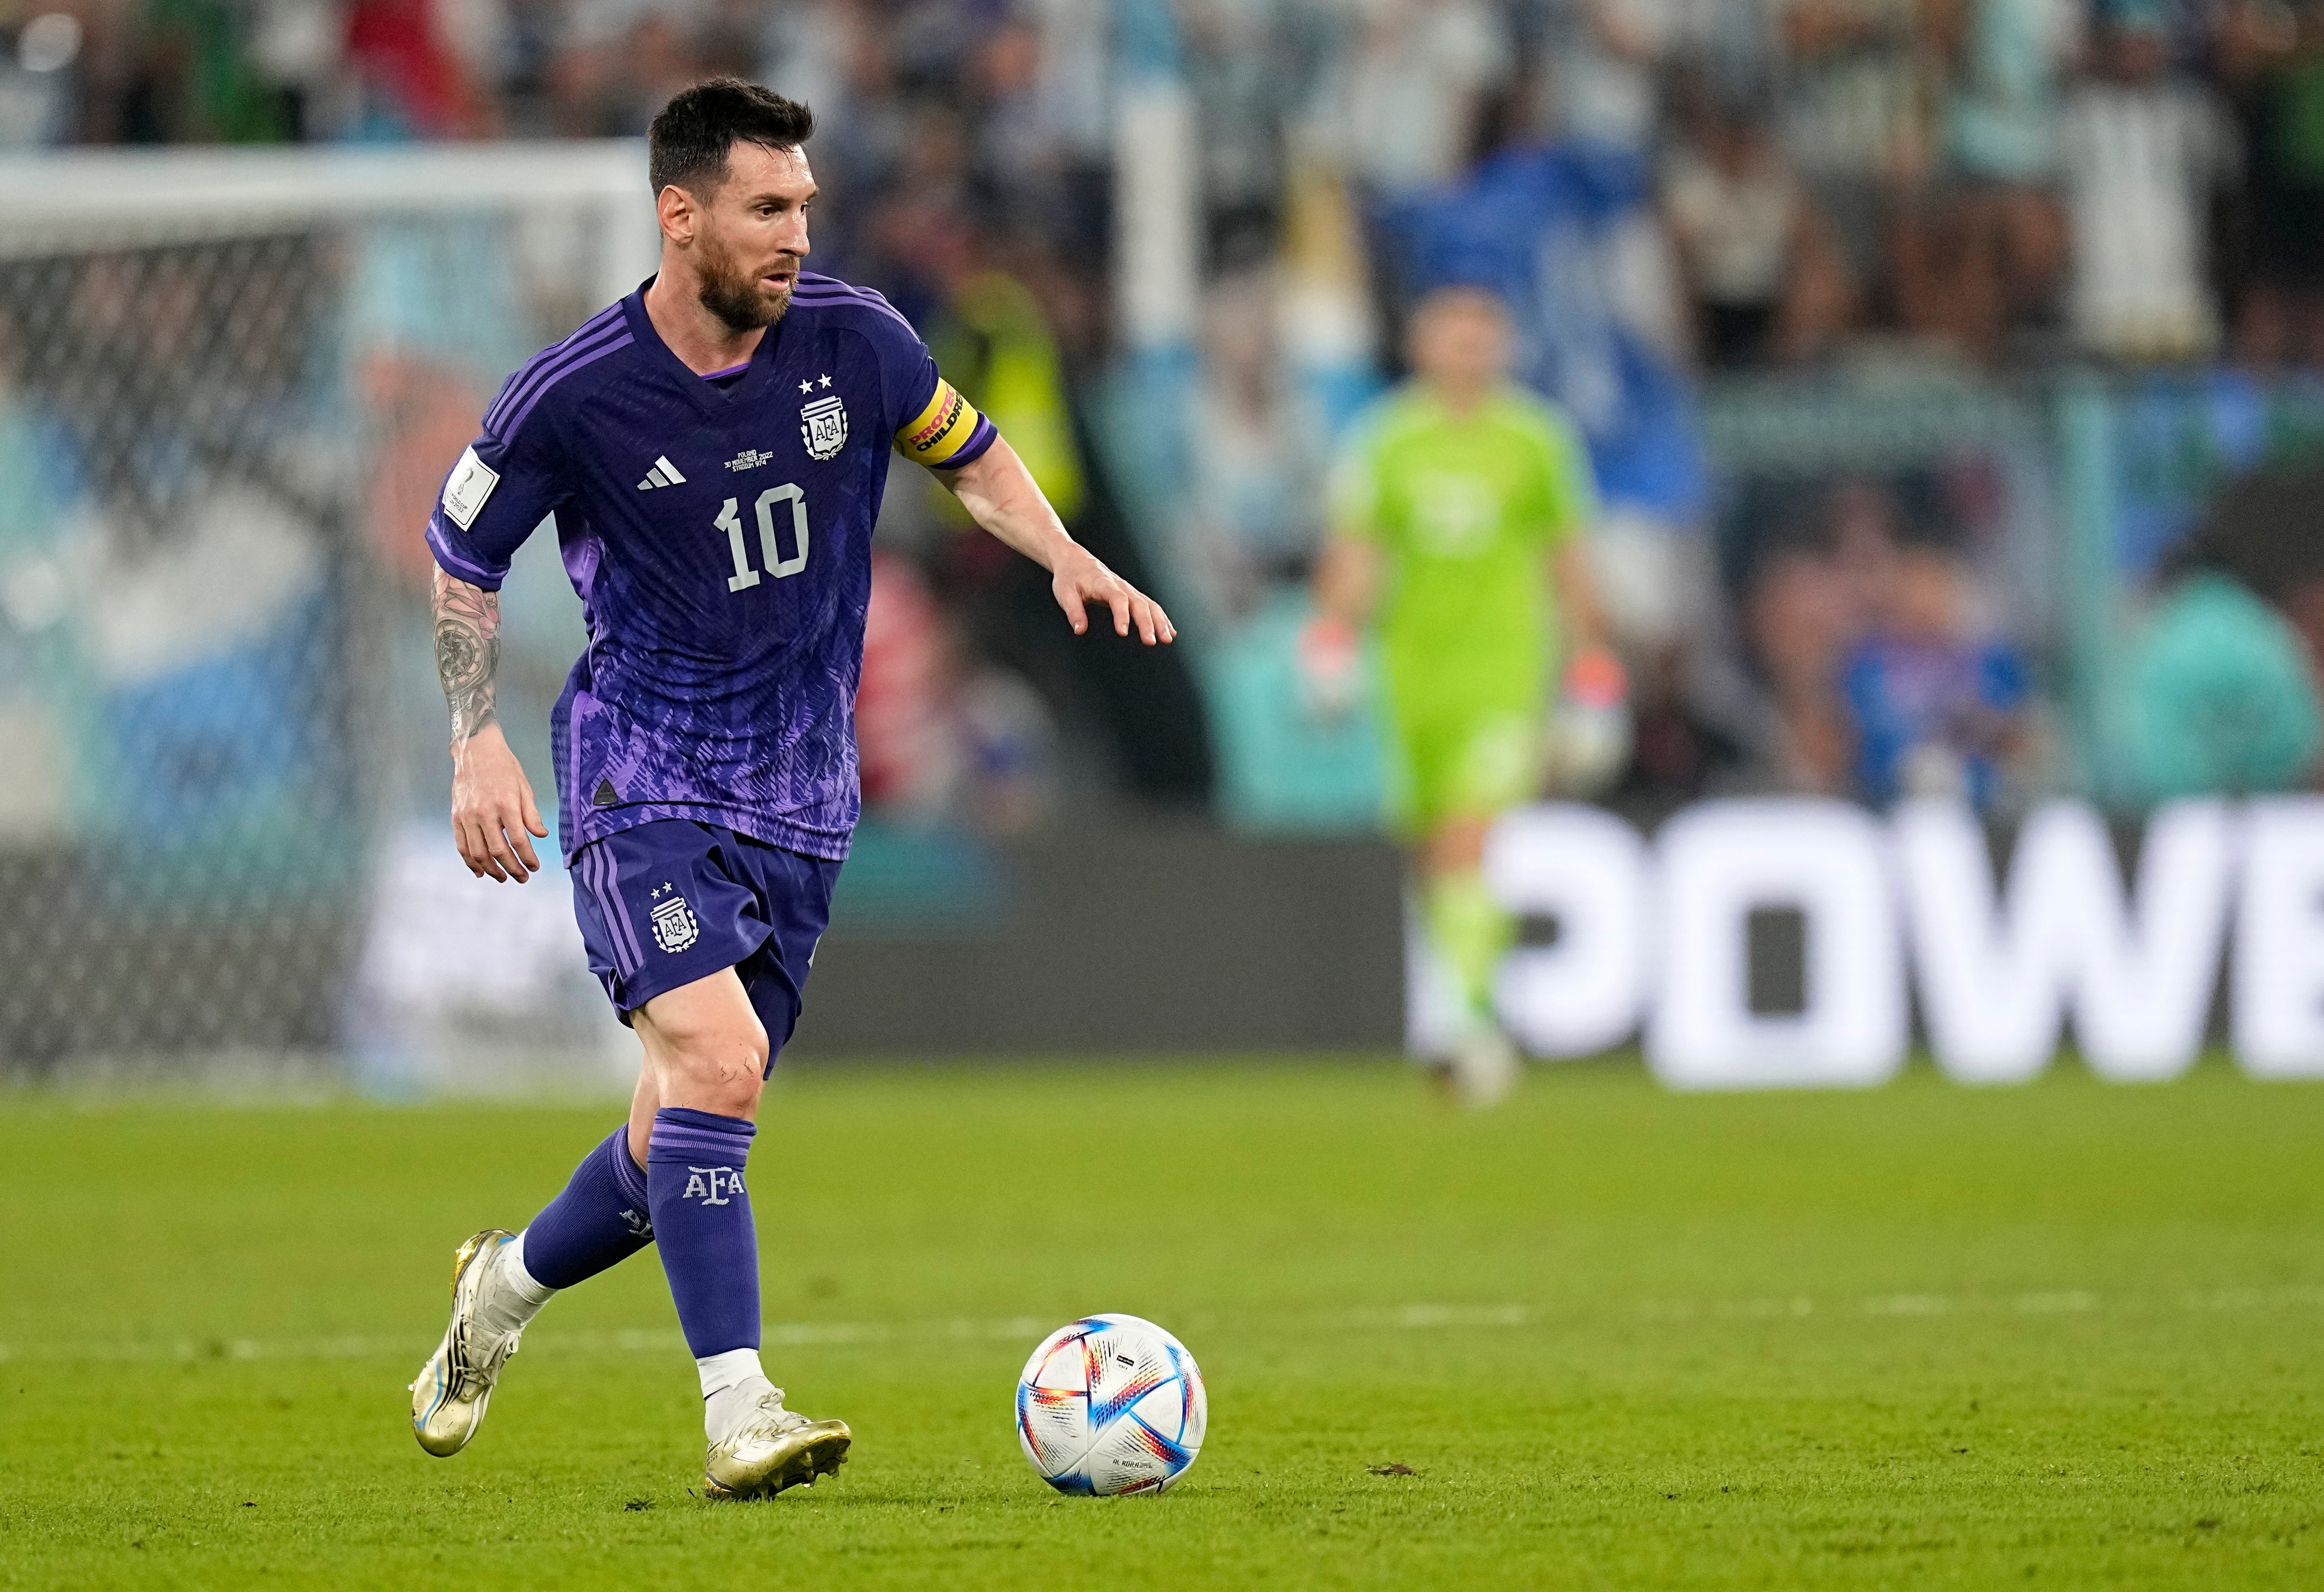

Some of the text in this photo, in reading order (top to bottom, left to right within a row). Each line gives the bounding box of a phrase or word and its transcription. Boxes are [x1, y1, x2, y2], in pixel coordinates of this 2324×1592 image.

[908, 382, 954, 445] PROTEC
[917, 391, 963, 452] CHILDRE
[815, 414, 839, 441] AFA
[732, 455, 758, 466] NOVEMBER
[758, 451, 773, 460] 2022
[732, 462, 754, 472] STADIUM
[738, 449, 757, 459] POLAND
[713, 483, 809, 592] 10
[663, 913, 686, 937] AFA
[683, 1166, 744, 1205] AFA
